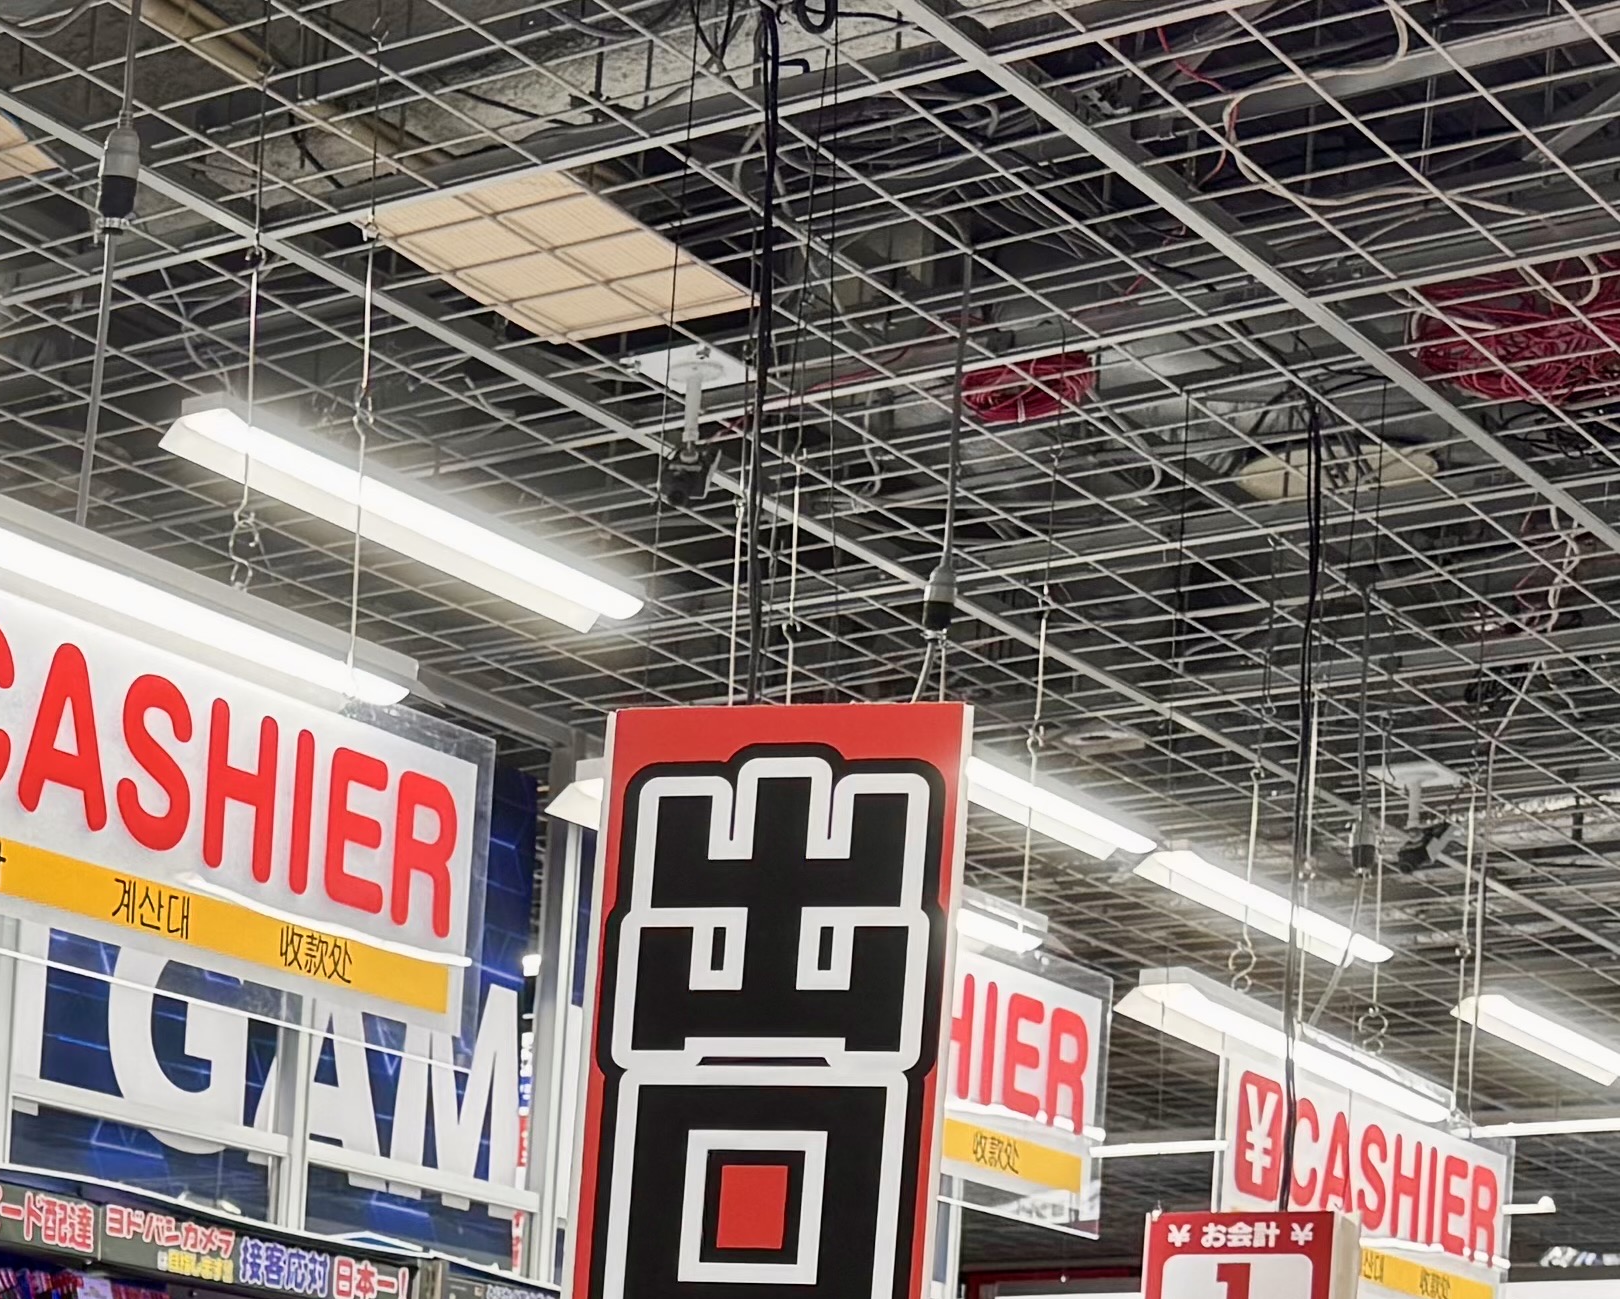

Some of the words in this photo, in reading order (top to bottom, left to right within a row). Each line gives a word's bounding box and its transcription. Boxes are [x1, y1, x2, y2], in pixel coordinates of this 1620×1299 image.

[110, 877, 193, 944] 계산대
[277, 926, 354, 987] 收款处
[1288, 1098, 1500, 1270] CASHIER
[105, 1203, 236, 1258] ヨドバシカメラ
[1200, 1220, 1280, 1250] お会計
